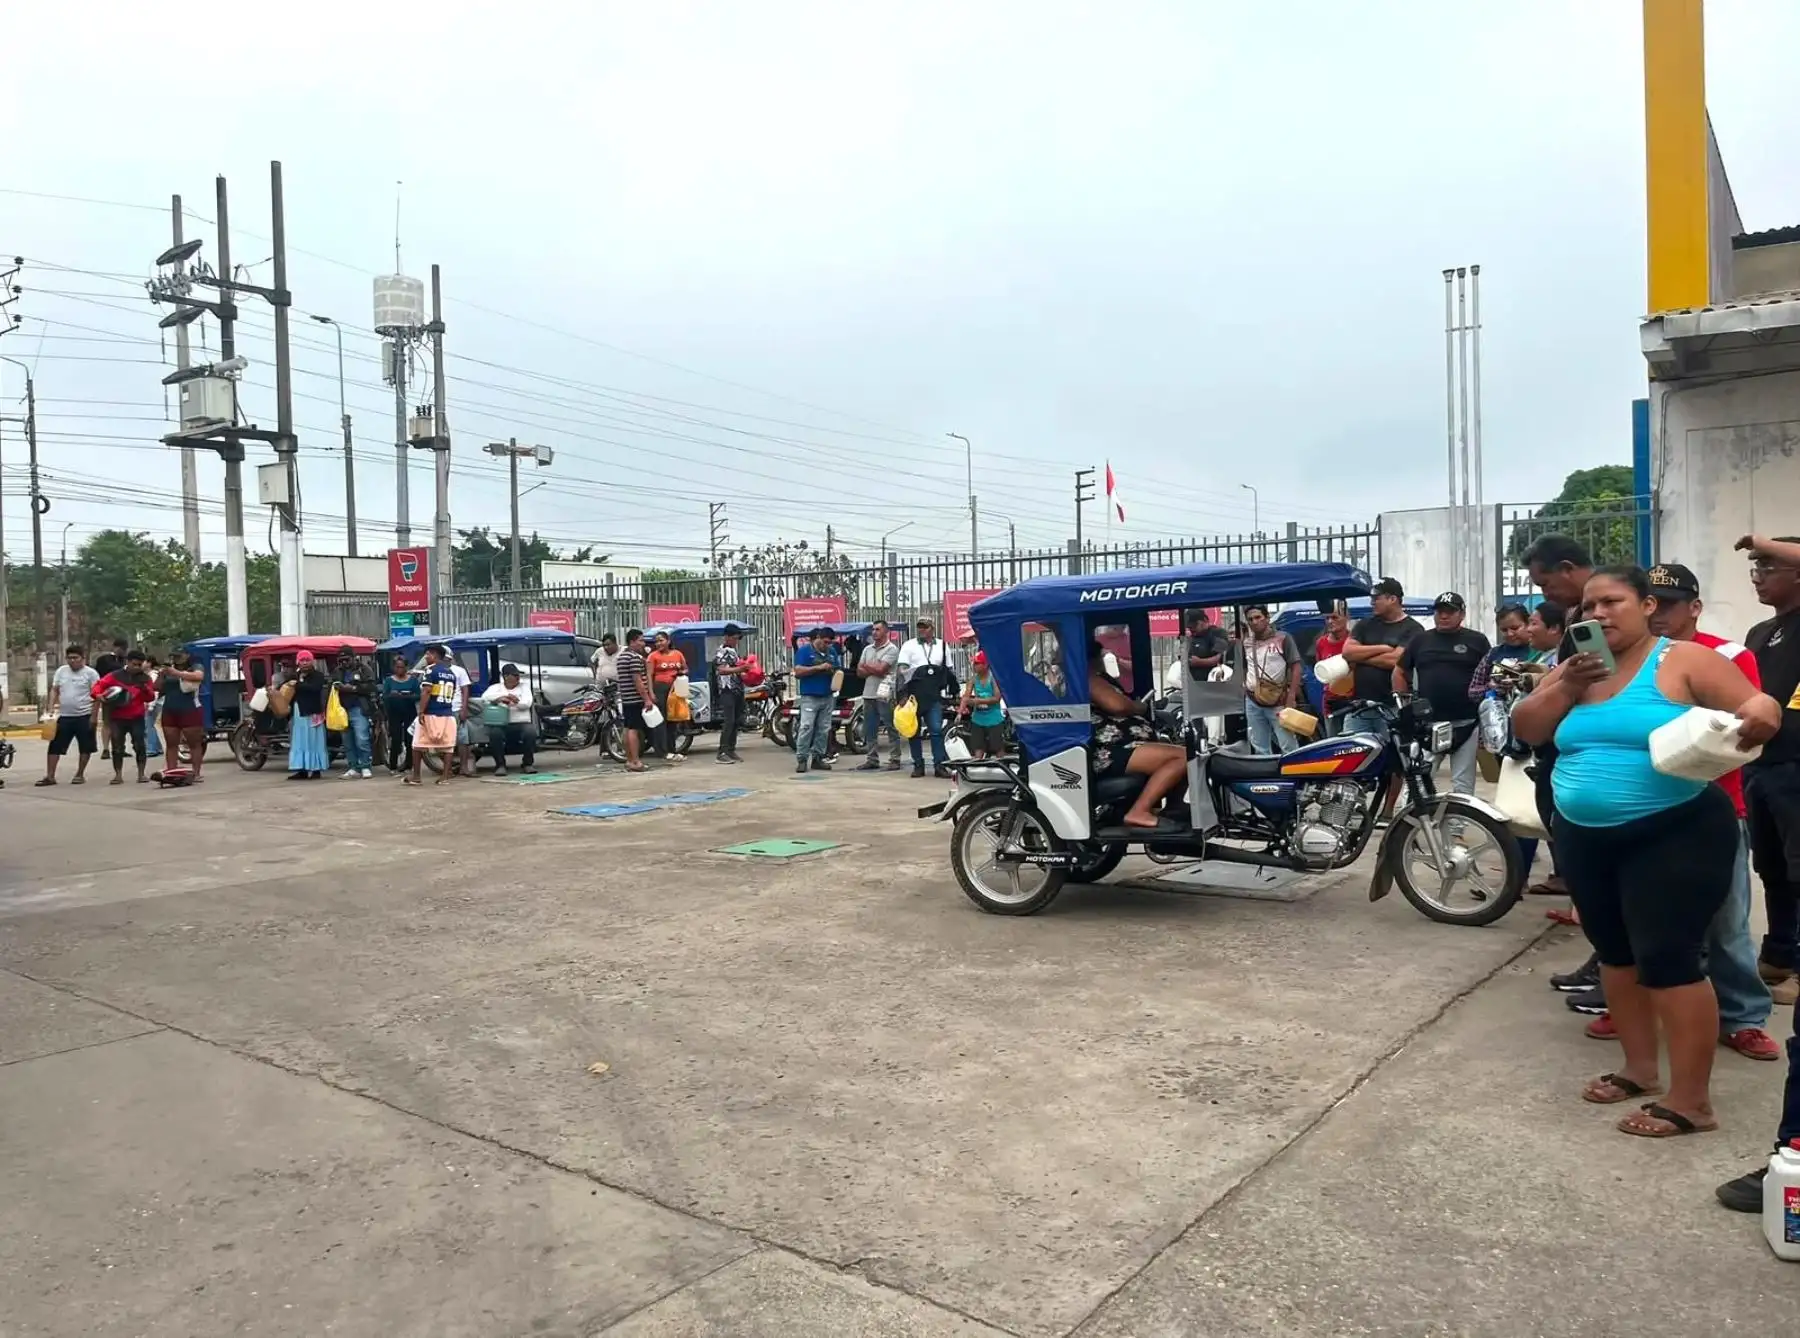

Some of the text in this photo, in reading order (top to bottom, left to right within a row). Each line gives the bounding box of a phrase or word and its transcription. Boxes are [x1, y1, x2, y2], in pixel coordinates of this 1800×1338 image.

[1079, 581, 1188, 603] MOTOKAR
[436, 681, 454, 703] 10
[1030, 711, 1072, 720] HONDA
